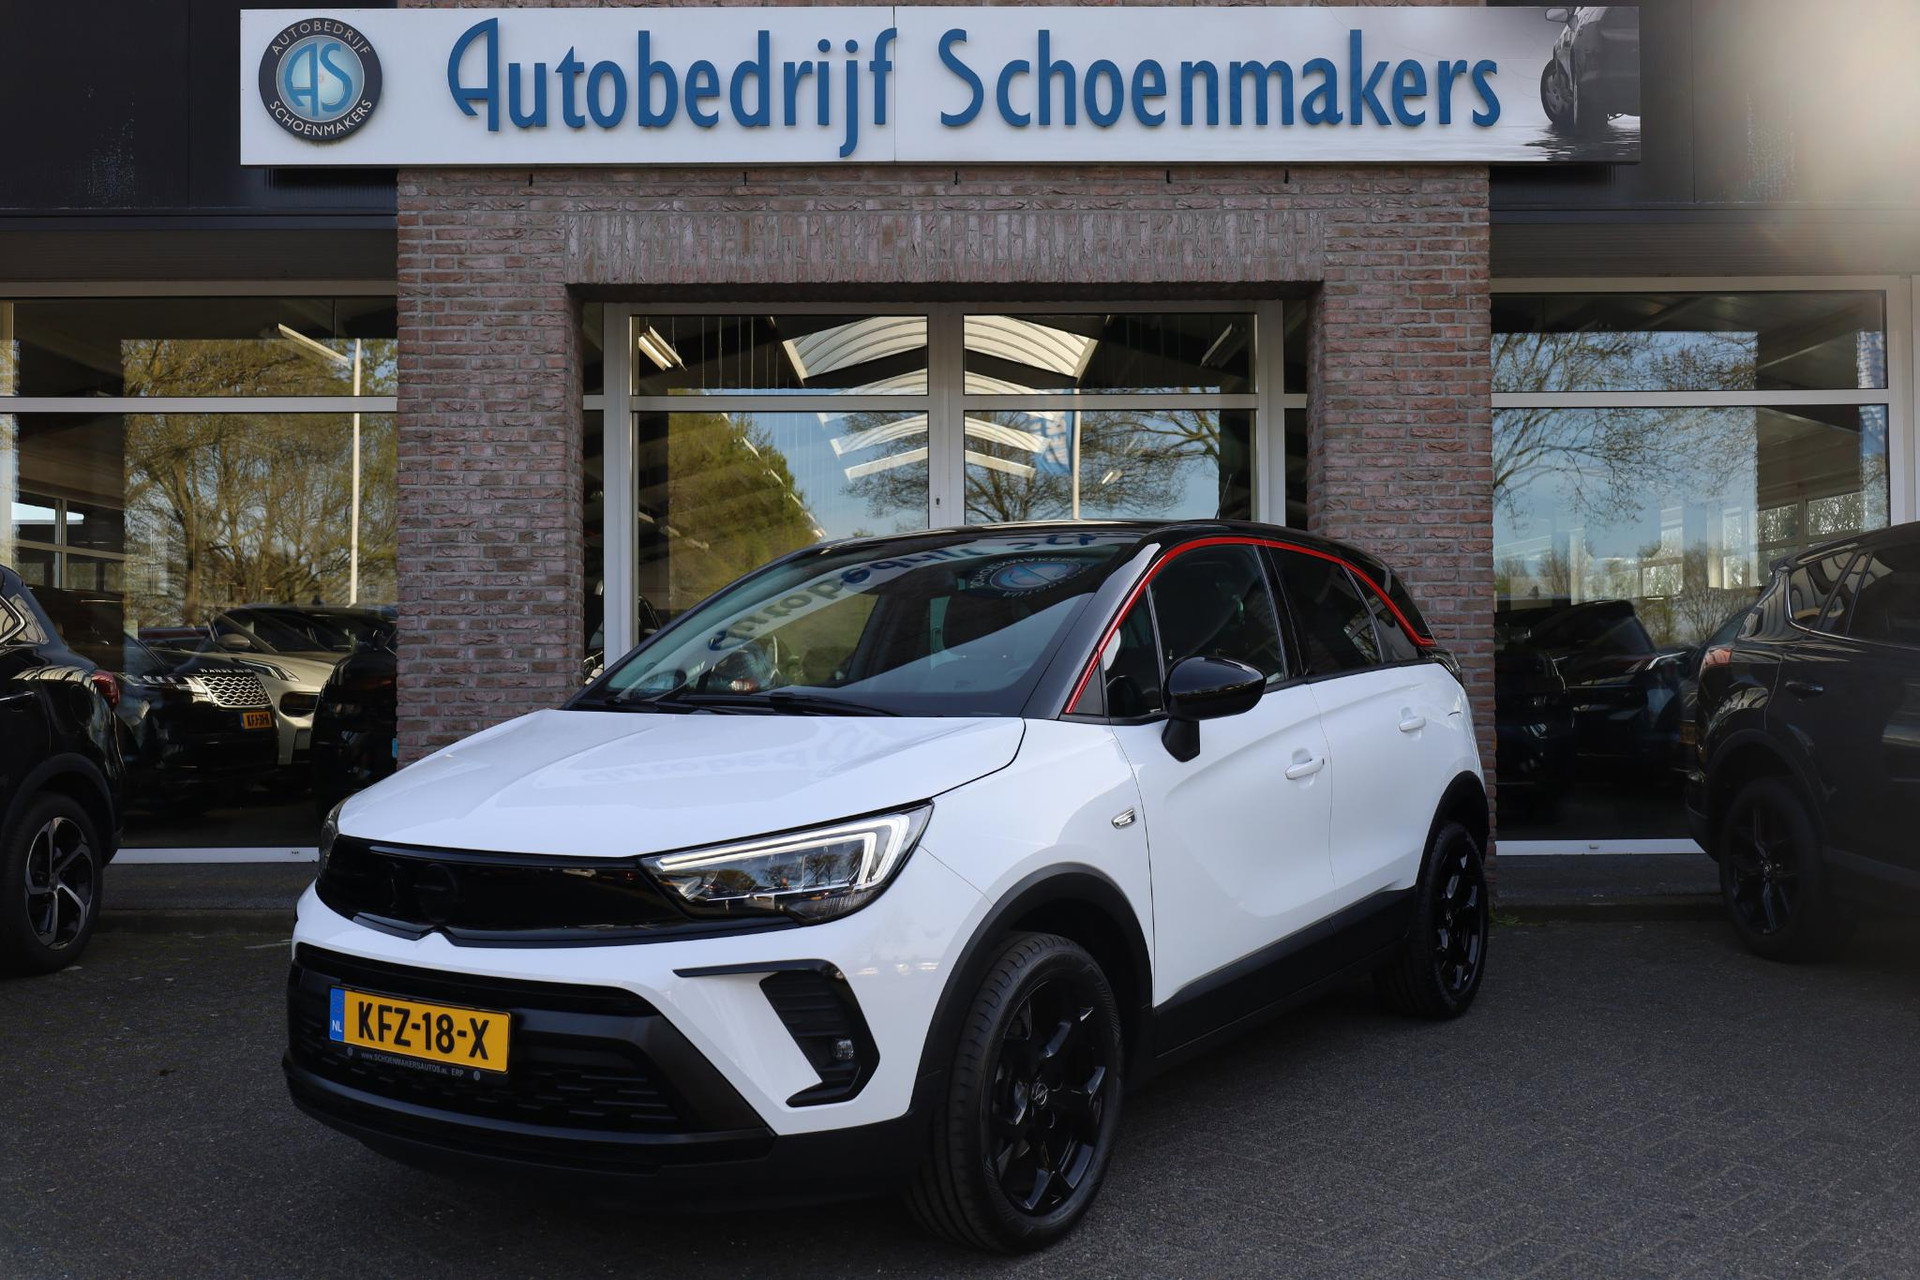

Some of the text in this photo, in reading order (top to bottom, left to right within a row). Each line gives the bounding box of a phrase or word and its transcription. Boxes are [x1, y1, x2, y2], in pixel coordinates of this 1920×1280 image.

[271, 20, 371, 56] AUTOBEDRIJF
[284, 42, 353, 117] AS
[447, 17, 1500, 158] Autobedrijf Schoenmakers
[269, 99, 372, 136] SCHOENMAKERS
[331, 1019, 343, 1033] NL
[357, 1001, 490, 1060] KFZ-18-X
